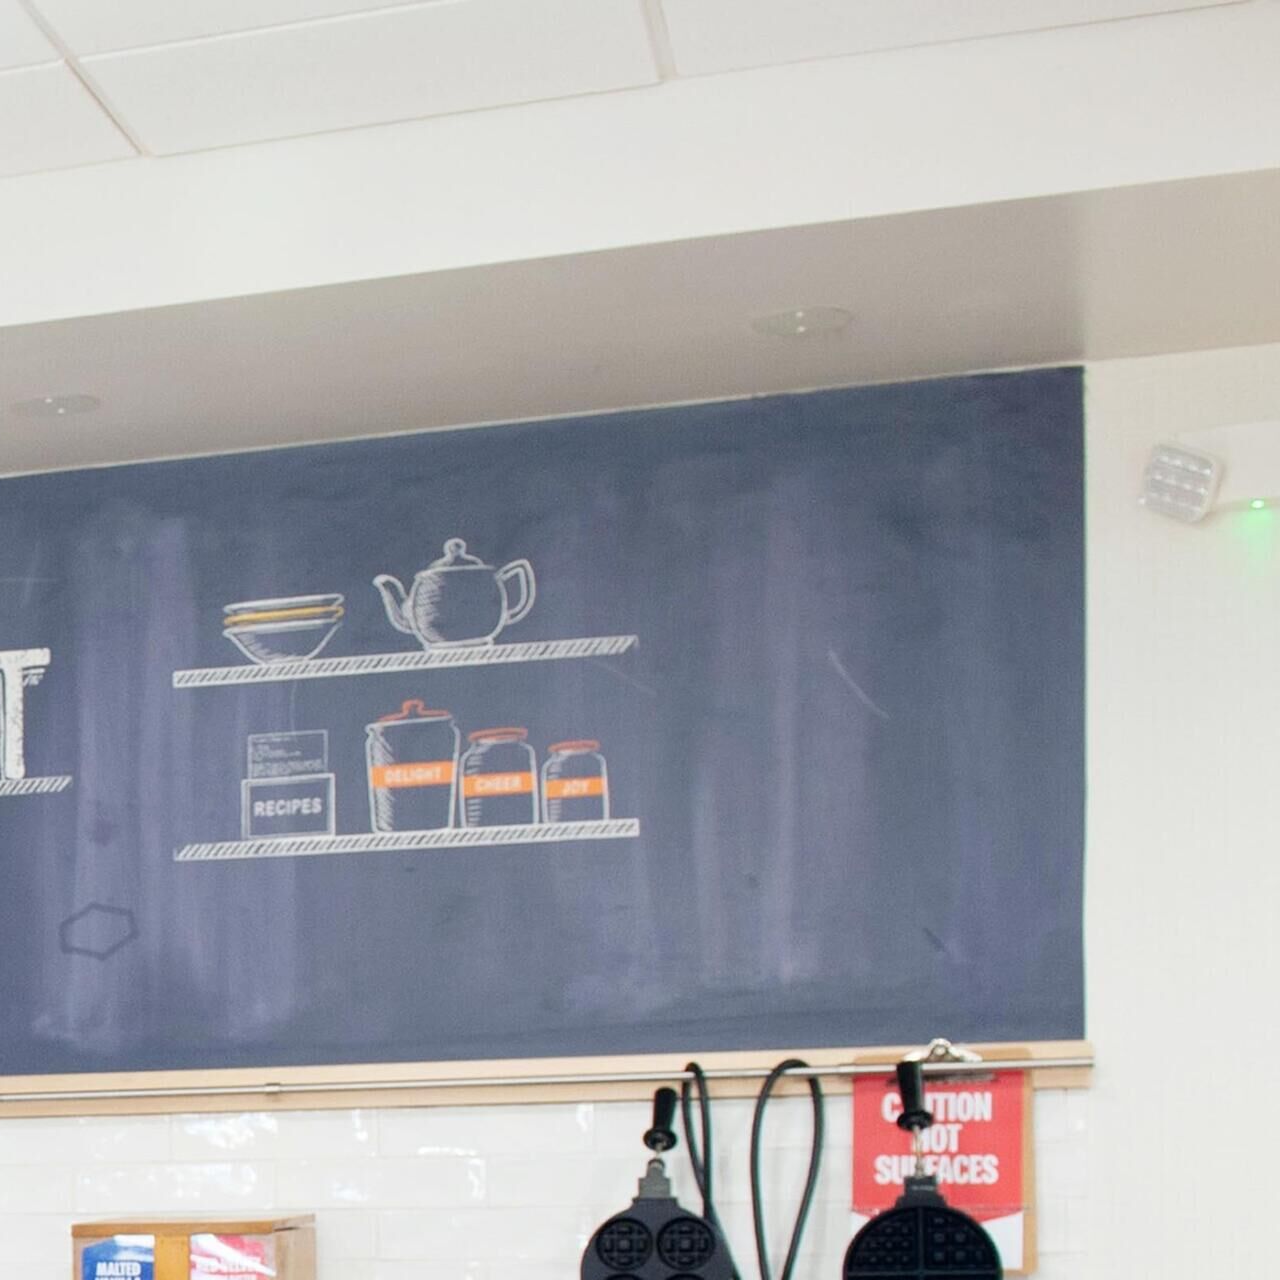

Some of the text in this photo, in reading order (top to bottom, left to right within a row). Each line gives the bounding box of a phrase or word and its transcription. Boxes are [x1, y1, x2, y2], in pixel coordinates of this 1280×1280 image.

[384, 766, 442, 783] DELIGHT
[475, 776, 522, 792] CHEER
[563, 780, 588, 796] JOY
[254, 798, 322, 817] RECIPES
[881, 1091, 992, 1122] CUTION
[874, 1154, 999, 1185] SUFACES
[96, 1262, 141, 1277] MALTED
